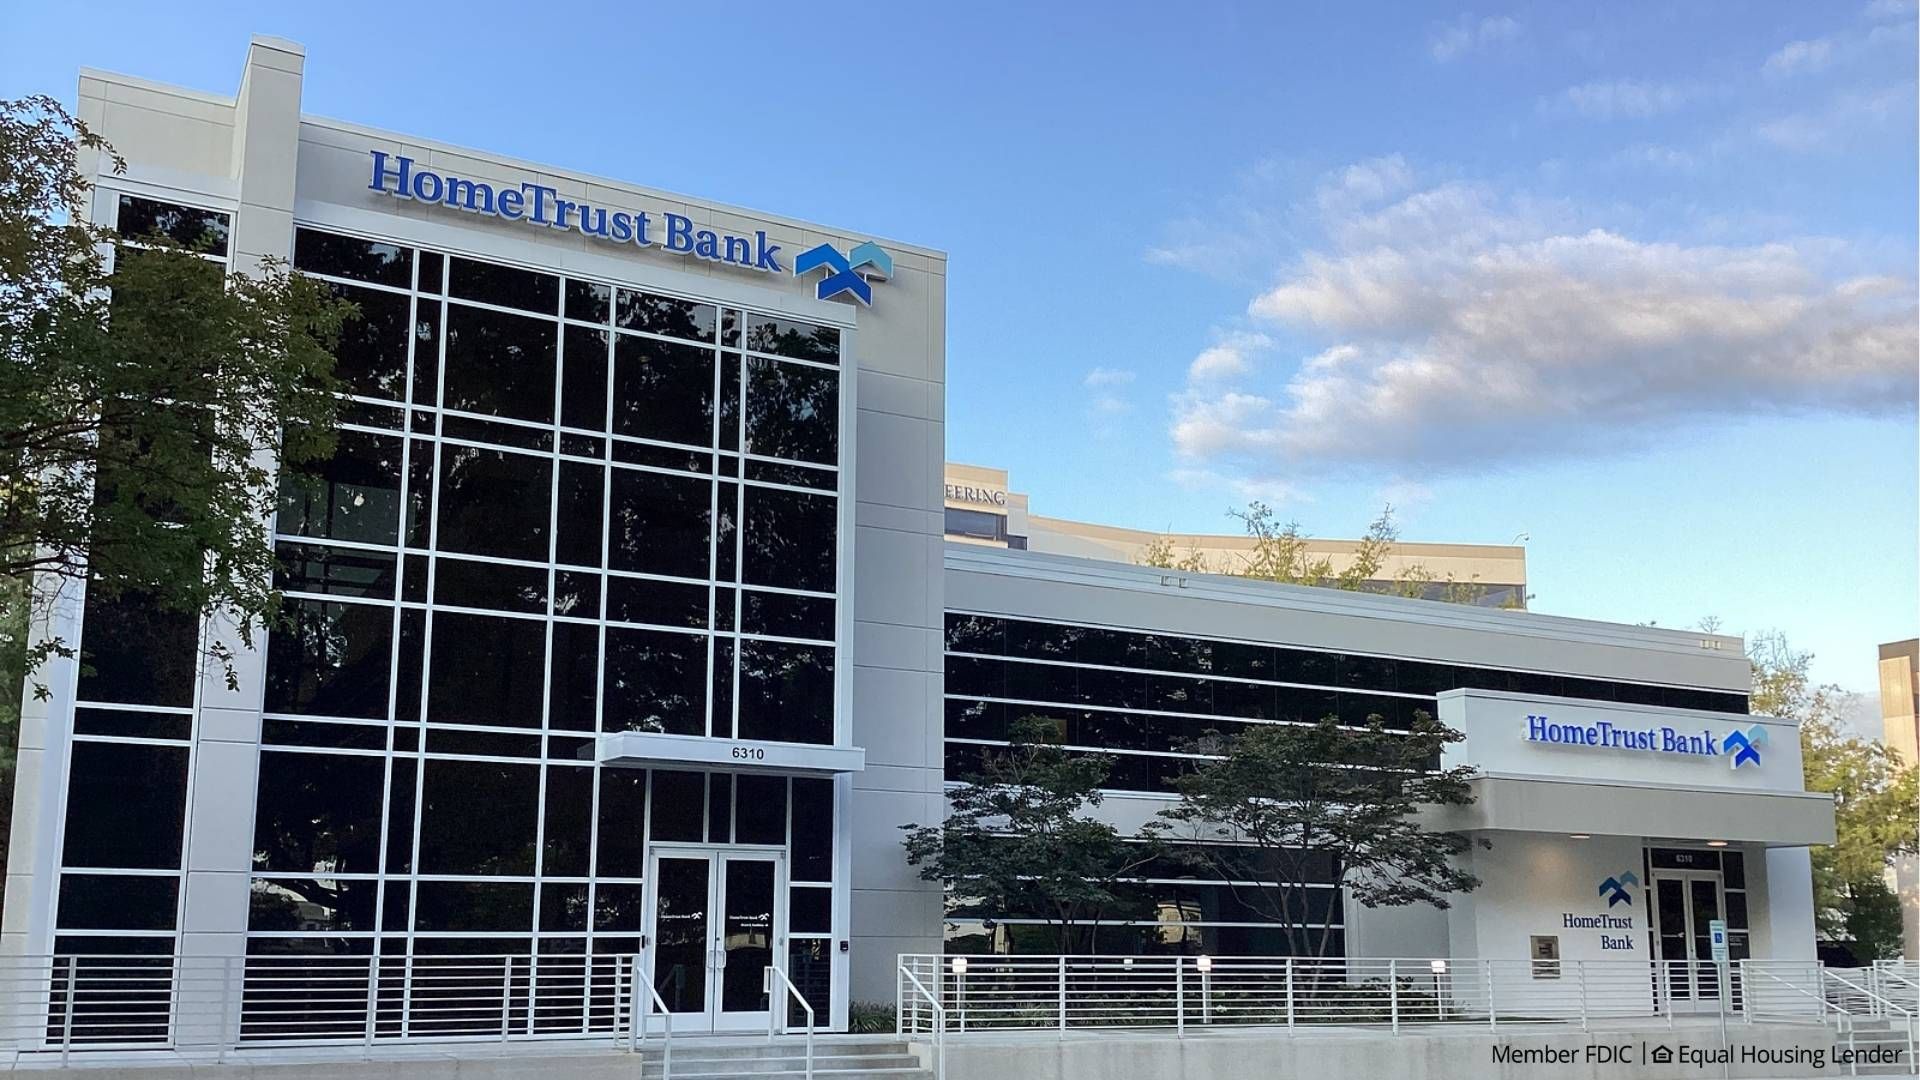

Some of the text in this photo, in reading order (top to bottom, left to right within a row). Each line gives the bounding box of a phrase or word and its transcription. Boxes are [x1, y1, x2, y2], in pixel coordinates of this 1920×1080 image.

[368, 150, 782, 273] HomeTrust Bank
[945, 484, 1005, 505] EERING
[1526, 715, 1719, 756] HomeTrust Bank
[732, 747, 764, 760] 6310
[1563, 913, 1633, 929] HomeTrust
[1601, 935, 1634, 950] Bank
